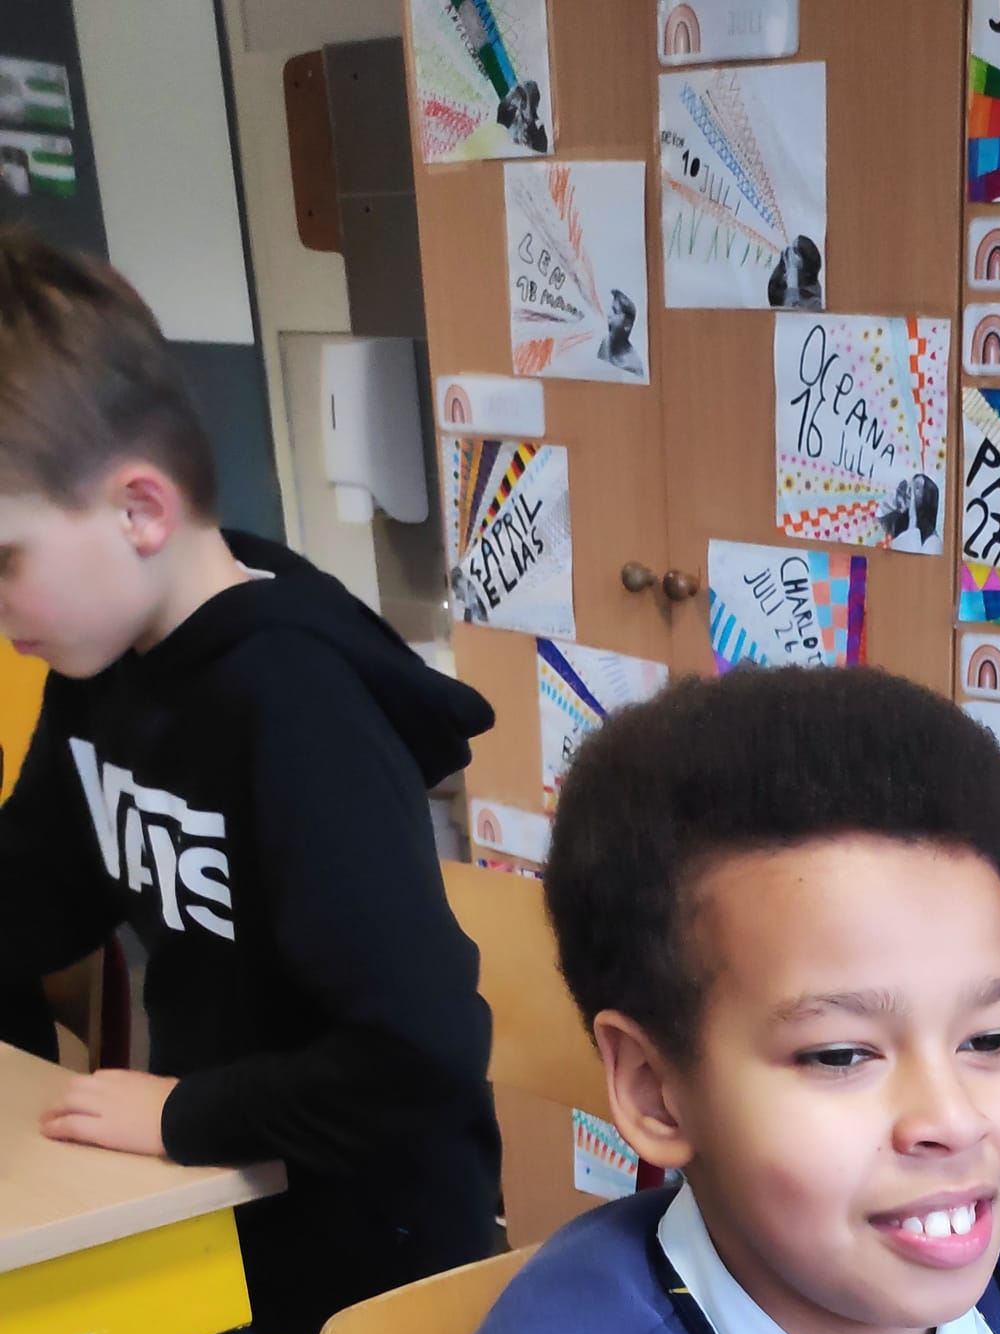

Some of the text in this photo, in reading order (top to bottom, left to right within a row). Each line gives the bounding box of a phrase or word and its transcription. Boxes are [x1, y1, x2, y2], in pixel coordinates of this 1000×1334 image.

[682, 150, 742, 216] 10 JULI
[518, 233, 566, 290] LEN
[790, 387, 874, 479] 16 JULI
[482, 526, 545, 609] ELIAS
[744, 568, 784, 616] JULI
[69, 736, 235, 942] VANS
